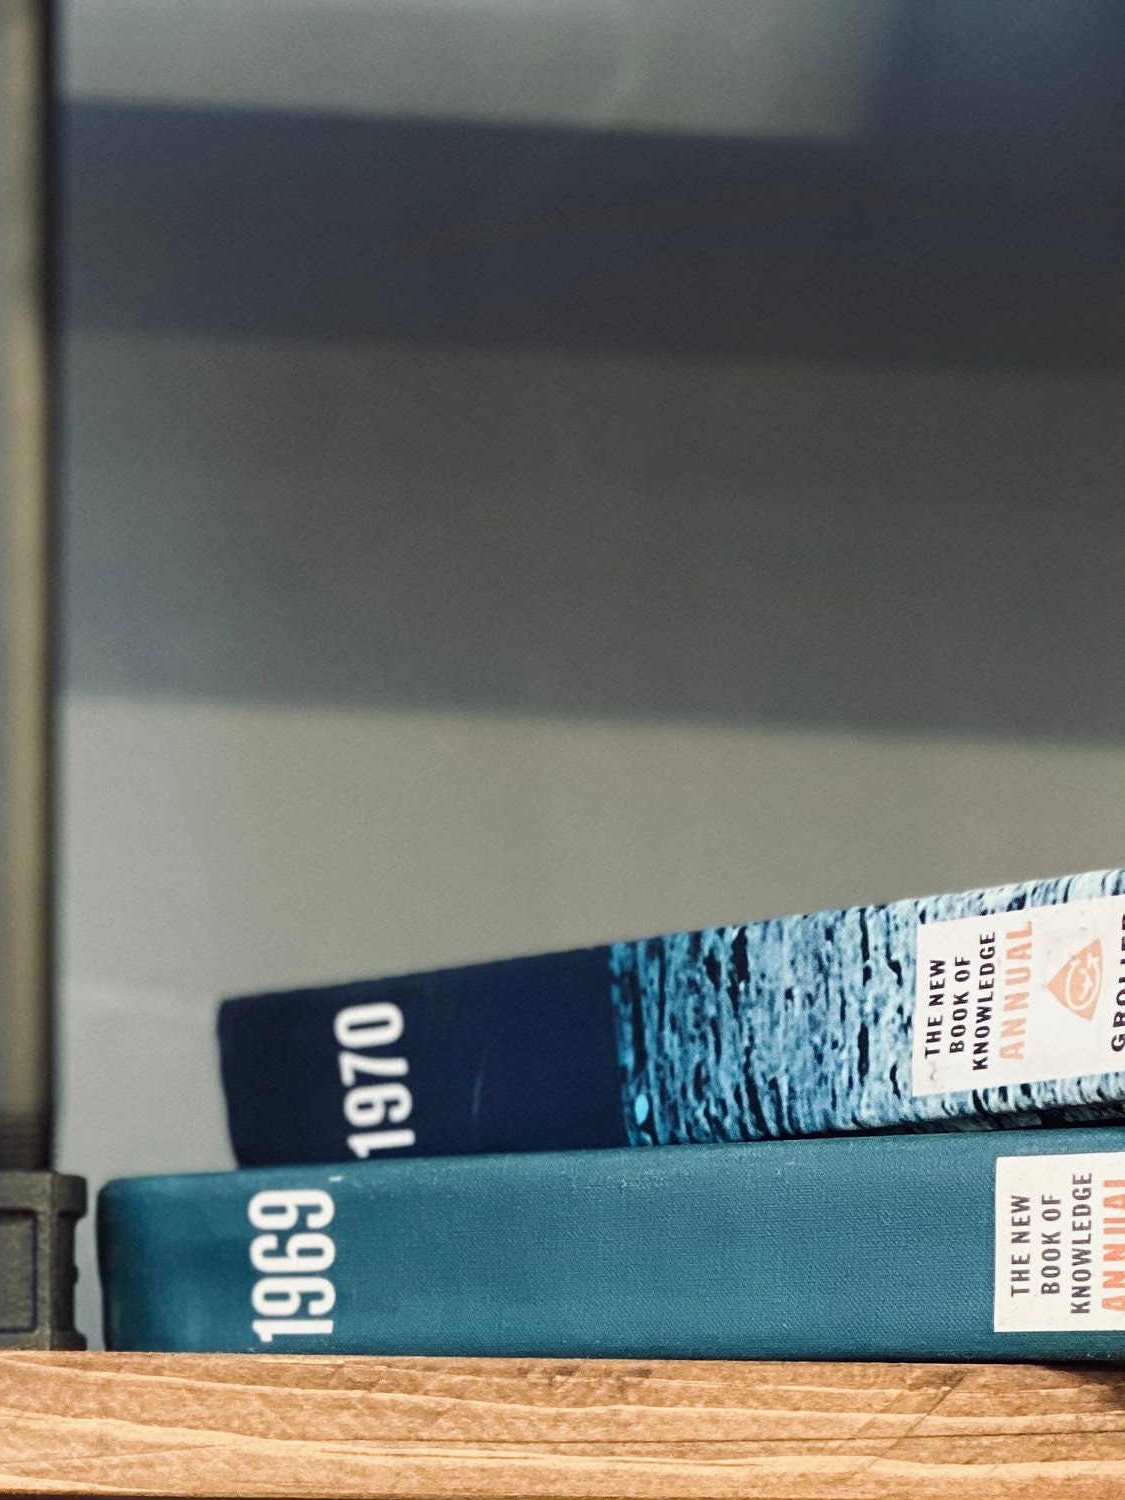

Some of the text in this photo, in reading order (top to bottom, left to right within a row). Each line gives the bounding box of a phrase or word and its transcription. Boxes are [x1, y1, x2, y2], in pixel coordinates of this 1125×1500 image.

[925, 959, 946, 1058] THE NEW
[949, 956, 971, 1054] BOOK OF
[972, 931, 996, 1070] KNOWLEDGE
[998, 920, 1032, 1060] ANNUAL
[334, 1002, 416, 1159] 1970
[248, 1189, 336, 1342] 1969
[1011, 1195, 1031, 1297] THE NEW
[1041, 1194, 1062, 1294] BOOK OF
[1070, 1173, 1092, 1314] KNOWLEDGE
